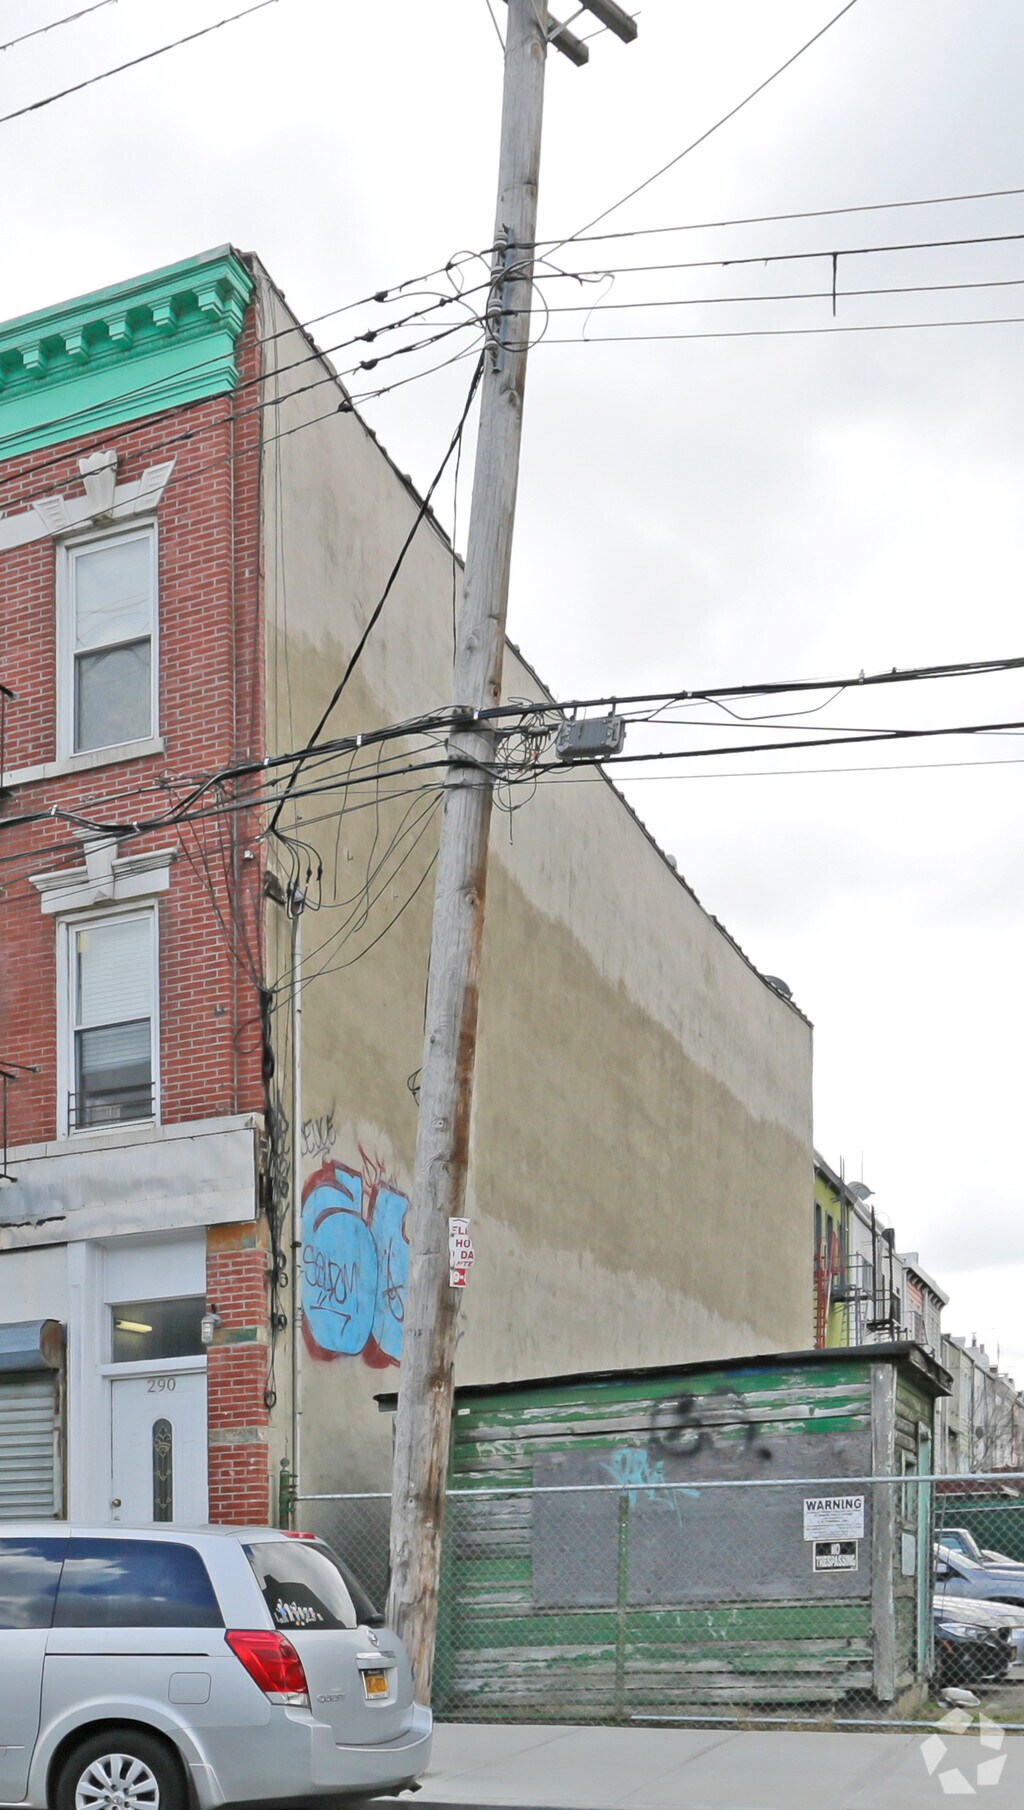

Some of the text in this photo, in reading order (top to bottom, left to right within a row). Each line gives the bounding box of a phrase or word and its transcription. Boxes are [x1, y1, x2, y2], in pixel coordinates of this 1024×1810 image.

[146, 1377, 177, 1393] 290
[806, 1499, 862, 1510] WARNING
[830, 1543, 841, 1555] NO
[816, 1555, 855, 1567] TRESPASSING
